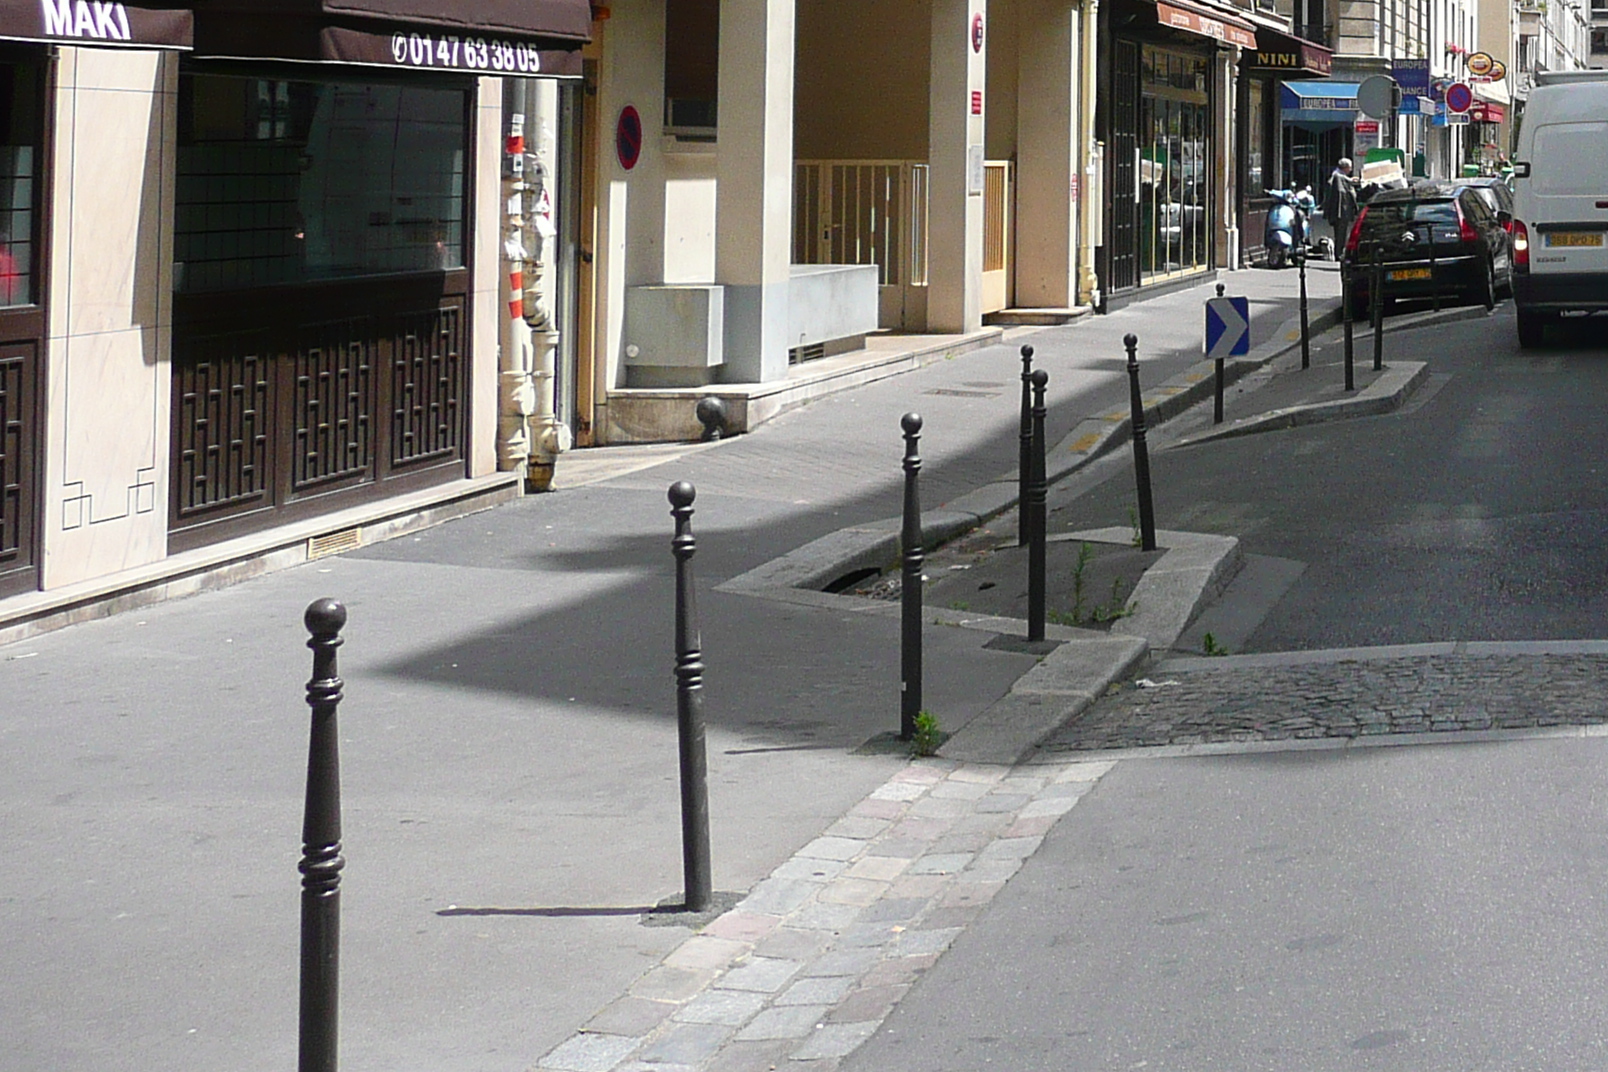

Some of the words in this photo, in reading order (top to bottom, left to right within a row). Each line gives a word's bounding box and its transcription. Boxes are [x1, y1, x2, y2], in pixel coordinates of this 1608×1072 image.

[409, 33, 434, 65] 01
[437, 35, 459, 66] 47
[464, 37, 488, 68] 63
[491, 40, 515, 70] 38
[516, 42, 540, 72] 05
[1257, 53, 1296, 66] NINI
